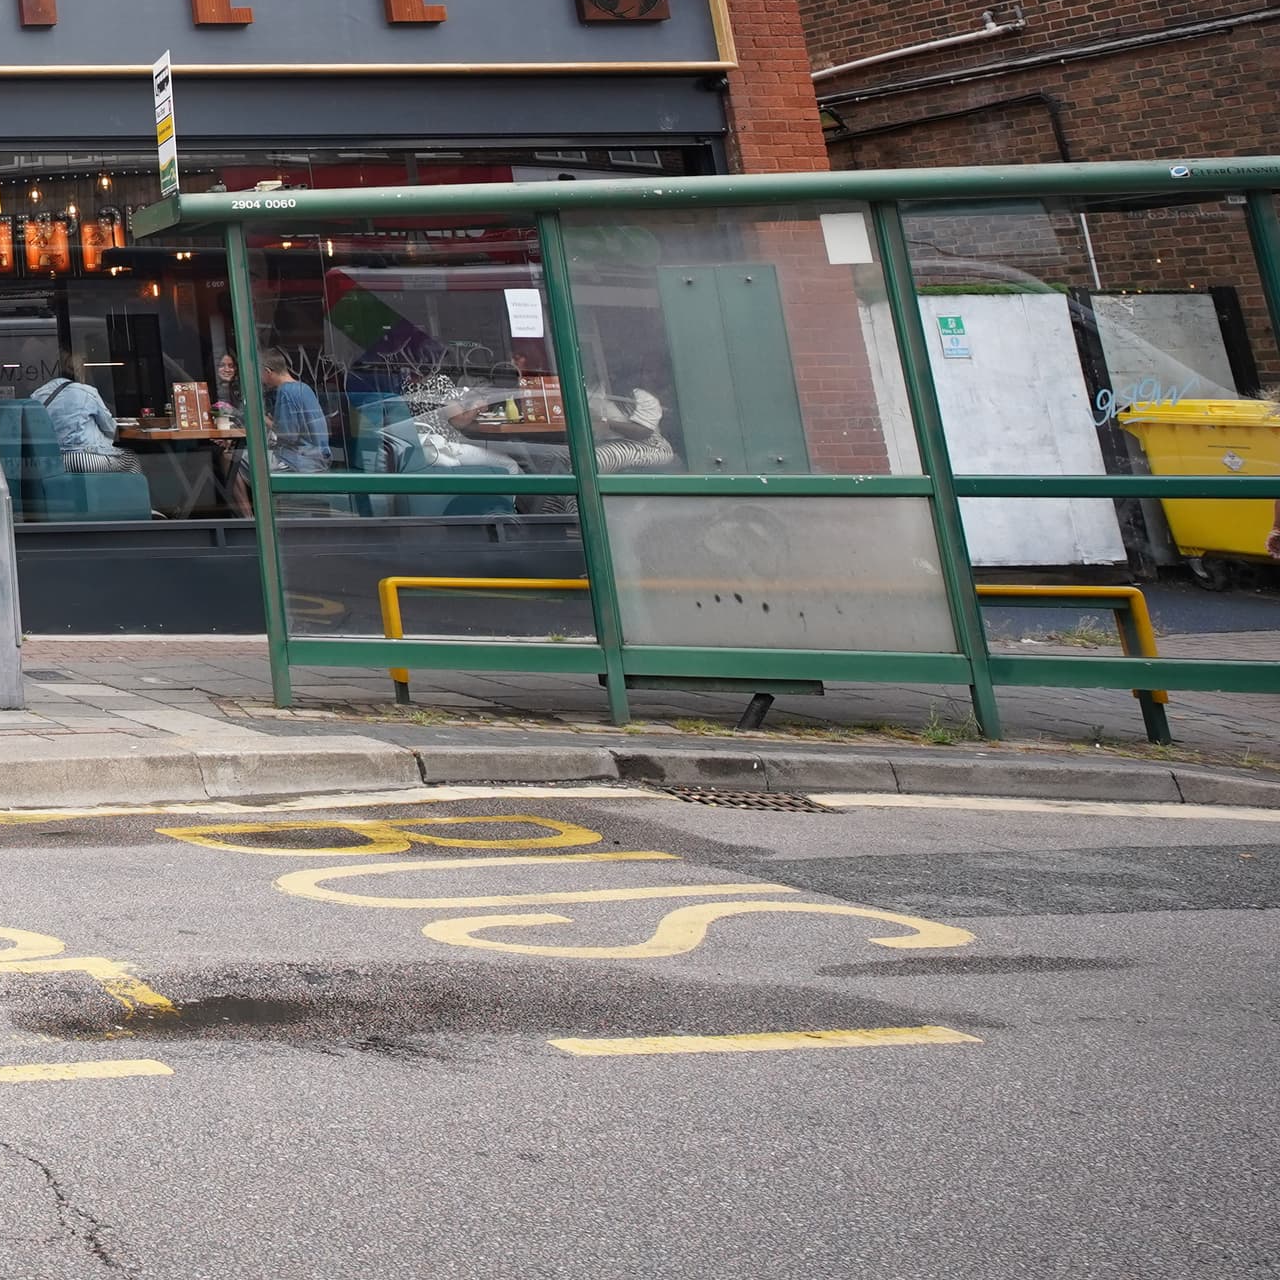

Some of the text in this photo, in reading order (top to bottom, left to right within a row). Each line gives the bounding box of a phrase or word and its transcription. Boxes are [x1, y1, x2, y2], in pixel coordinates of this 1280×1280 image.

[232, 199, 296, 209] 2904 0060
[156, 814, 974, 960] BUS
